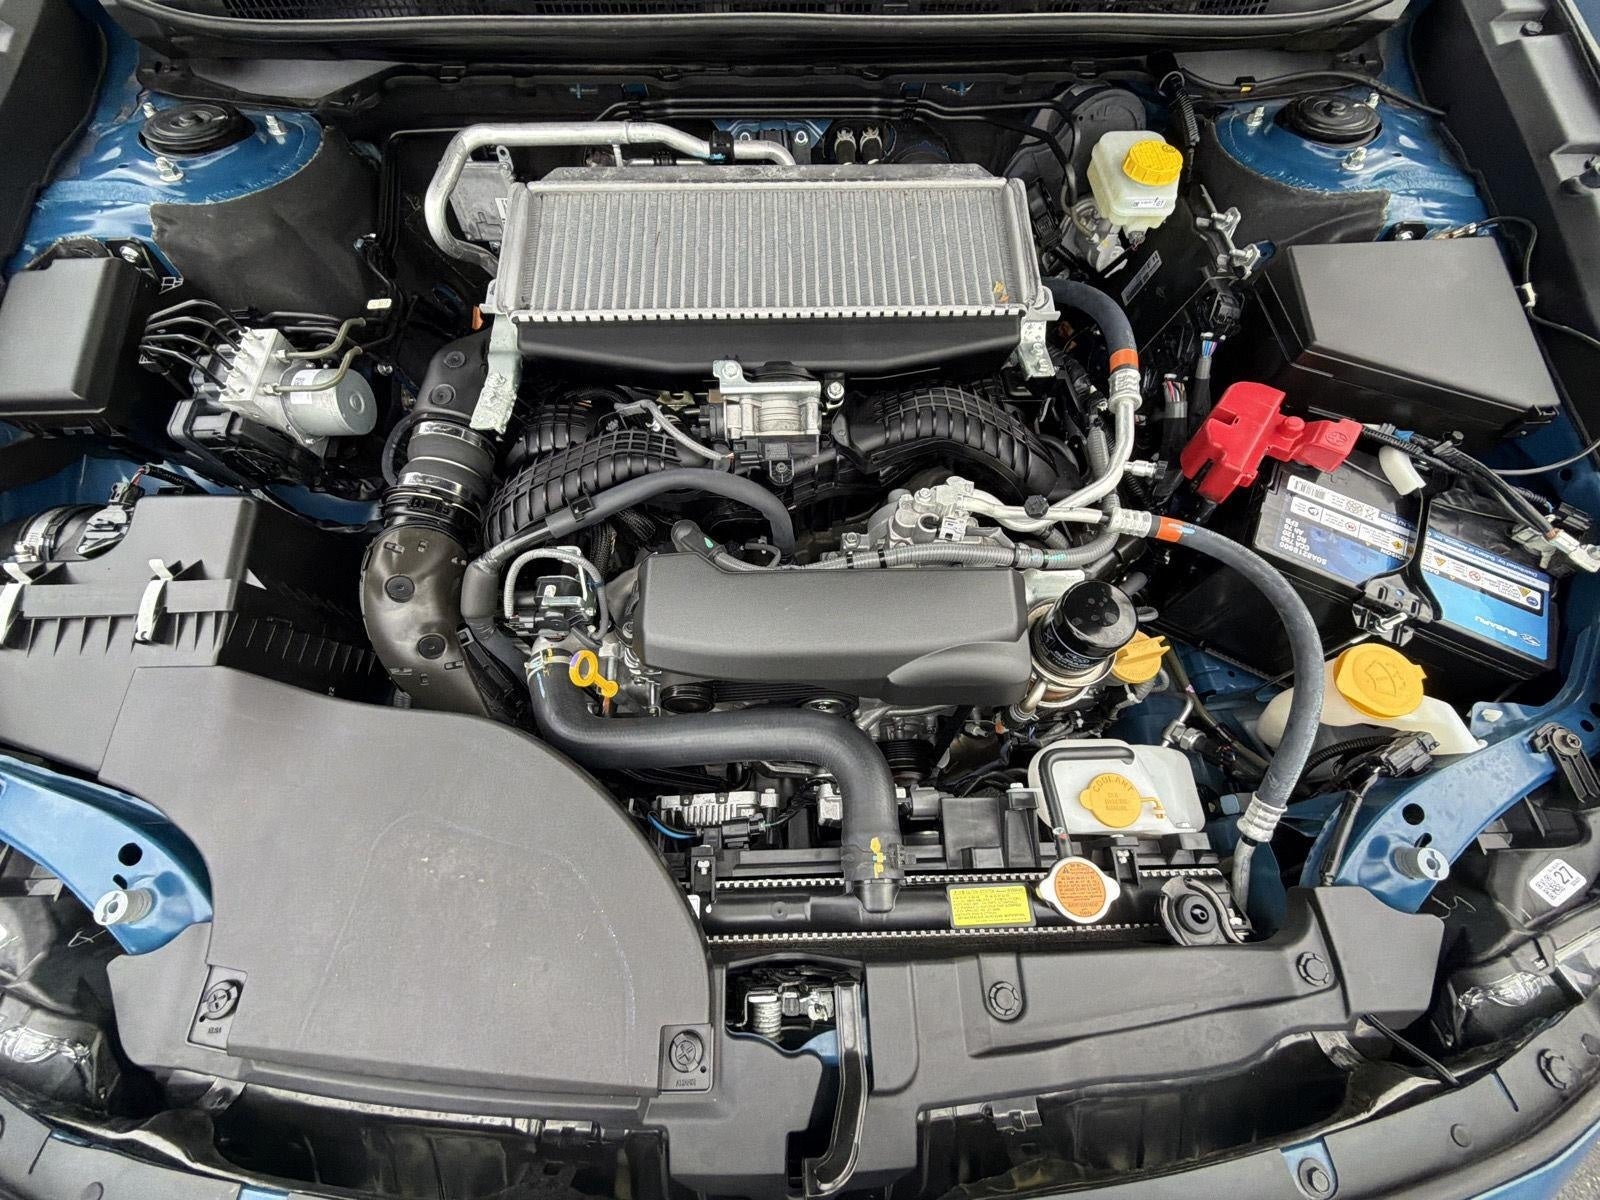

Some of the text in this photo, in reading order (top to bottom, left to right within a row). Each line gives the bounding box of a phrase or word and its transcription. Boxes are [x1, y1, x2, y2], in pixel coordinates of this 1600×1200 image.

[1474, 615, 1519, 637] SUBARU
[1093, 775, 1135, 793] COOLANT
[1553, 865, 1574, 885] 27
